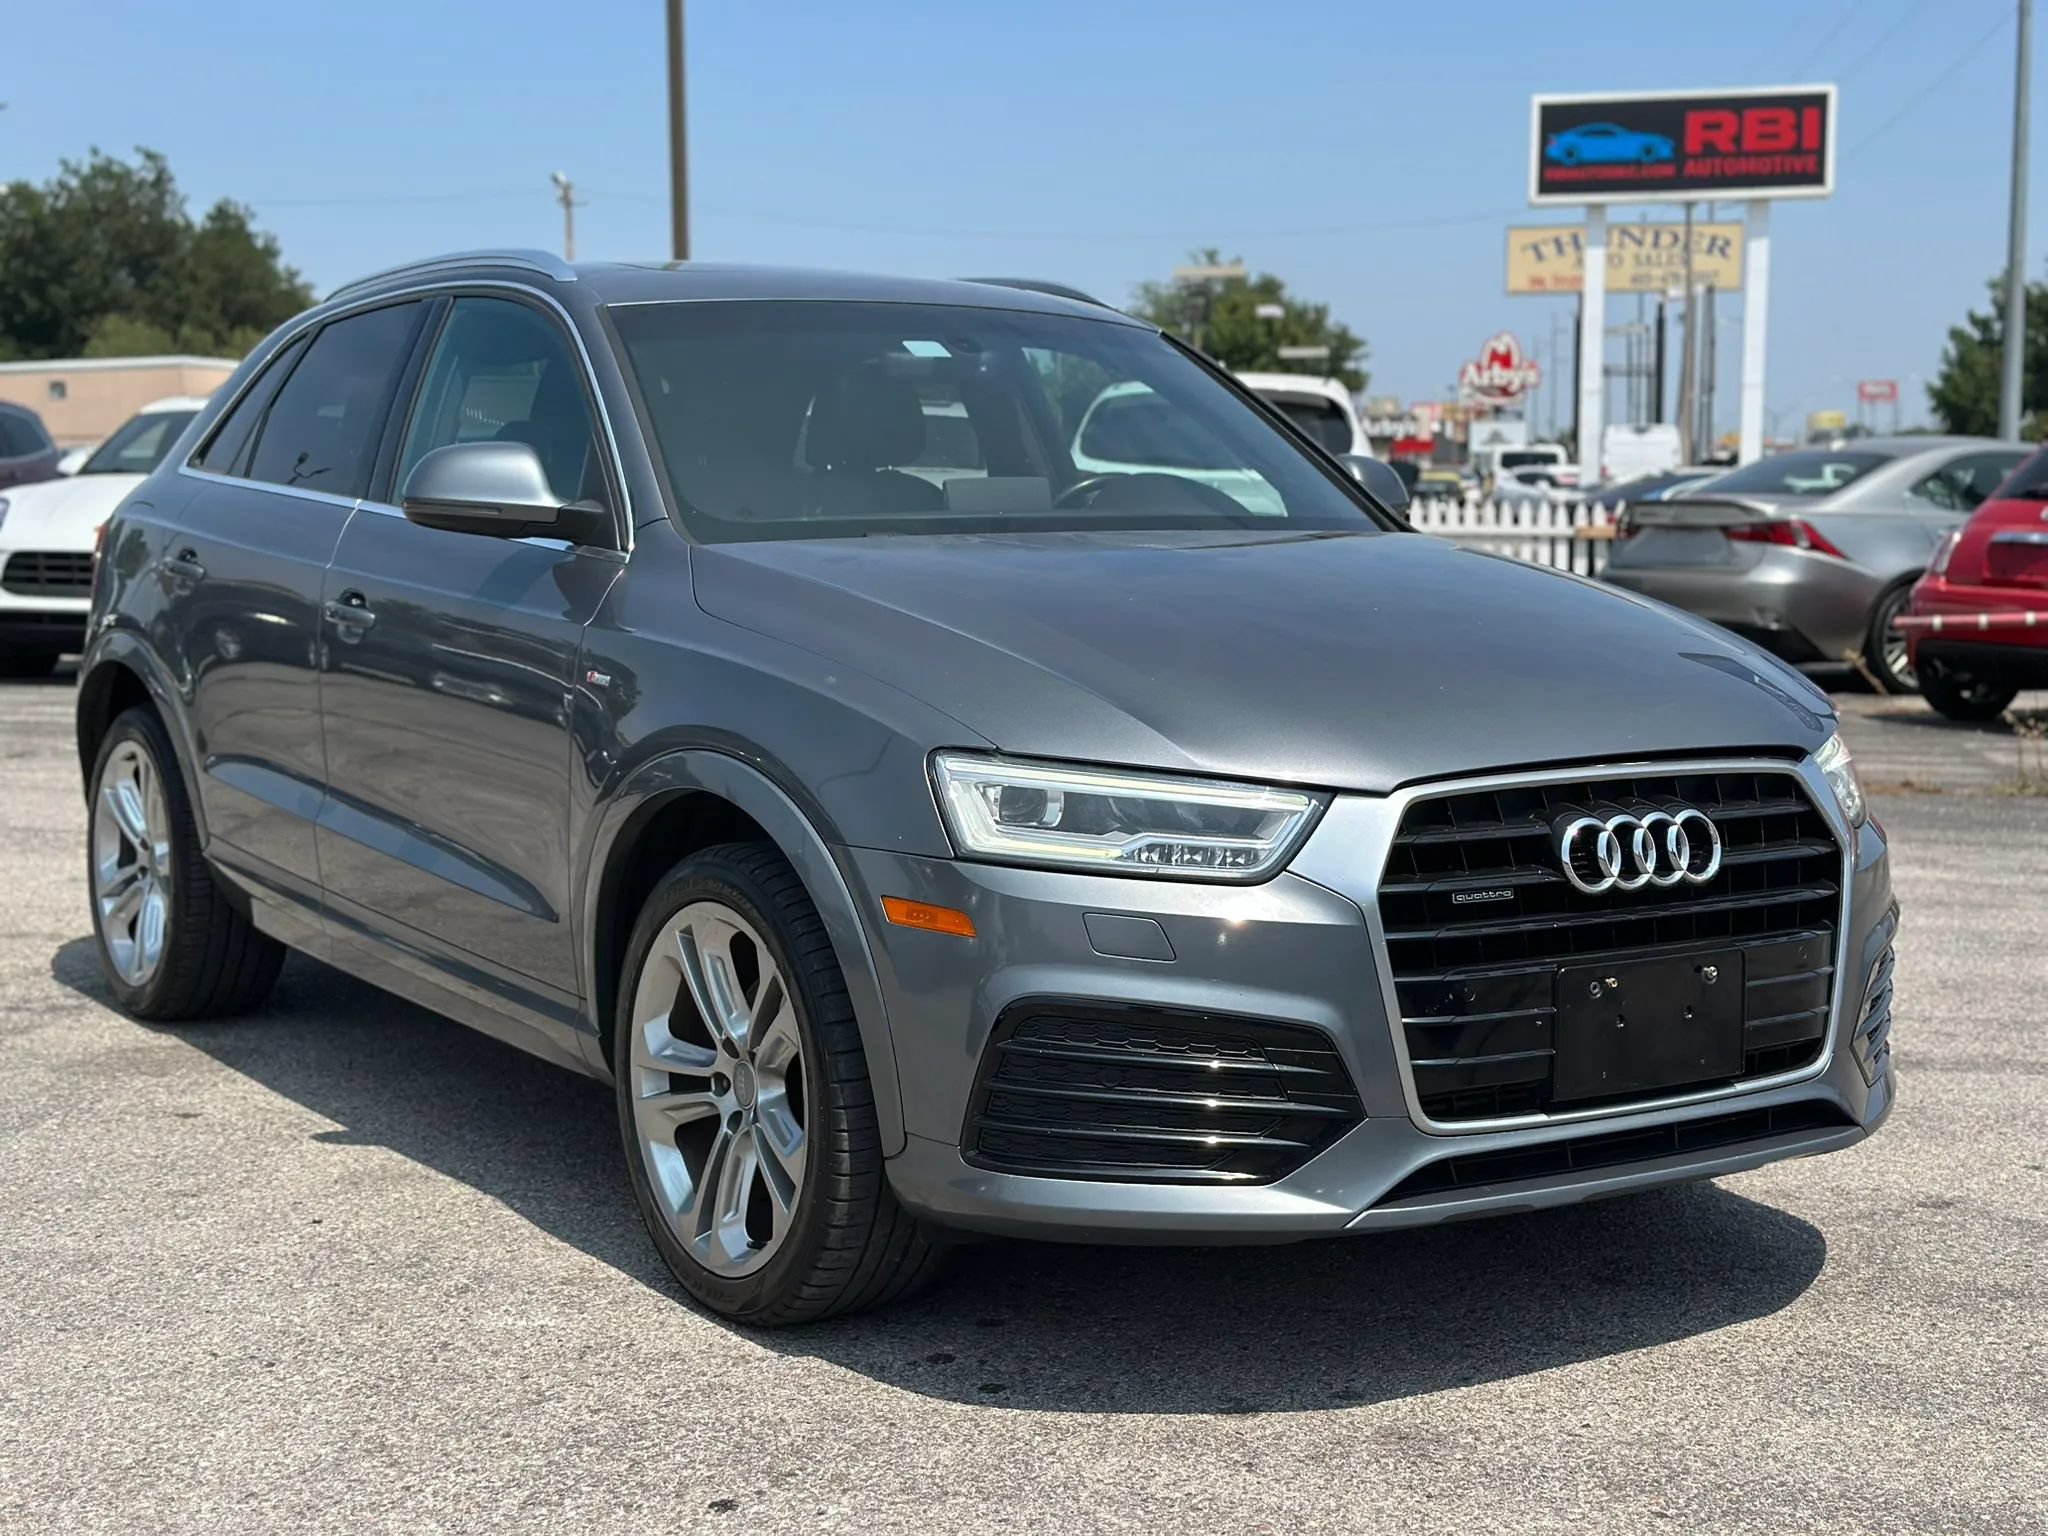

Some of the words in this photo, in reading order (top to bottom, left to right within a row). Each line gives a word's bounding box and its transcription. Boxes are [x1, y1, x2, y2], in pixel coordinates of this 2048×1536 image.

[1685, 107, 1821, 155] RBI
[1684, 154, 1818, 177] AUTOMOTIVE
[1461, 362, 1539, 393] Arby's
[1456, 890, 1511, 903] quattro
